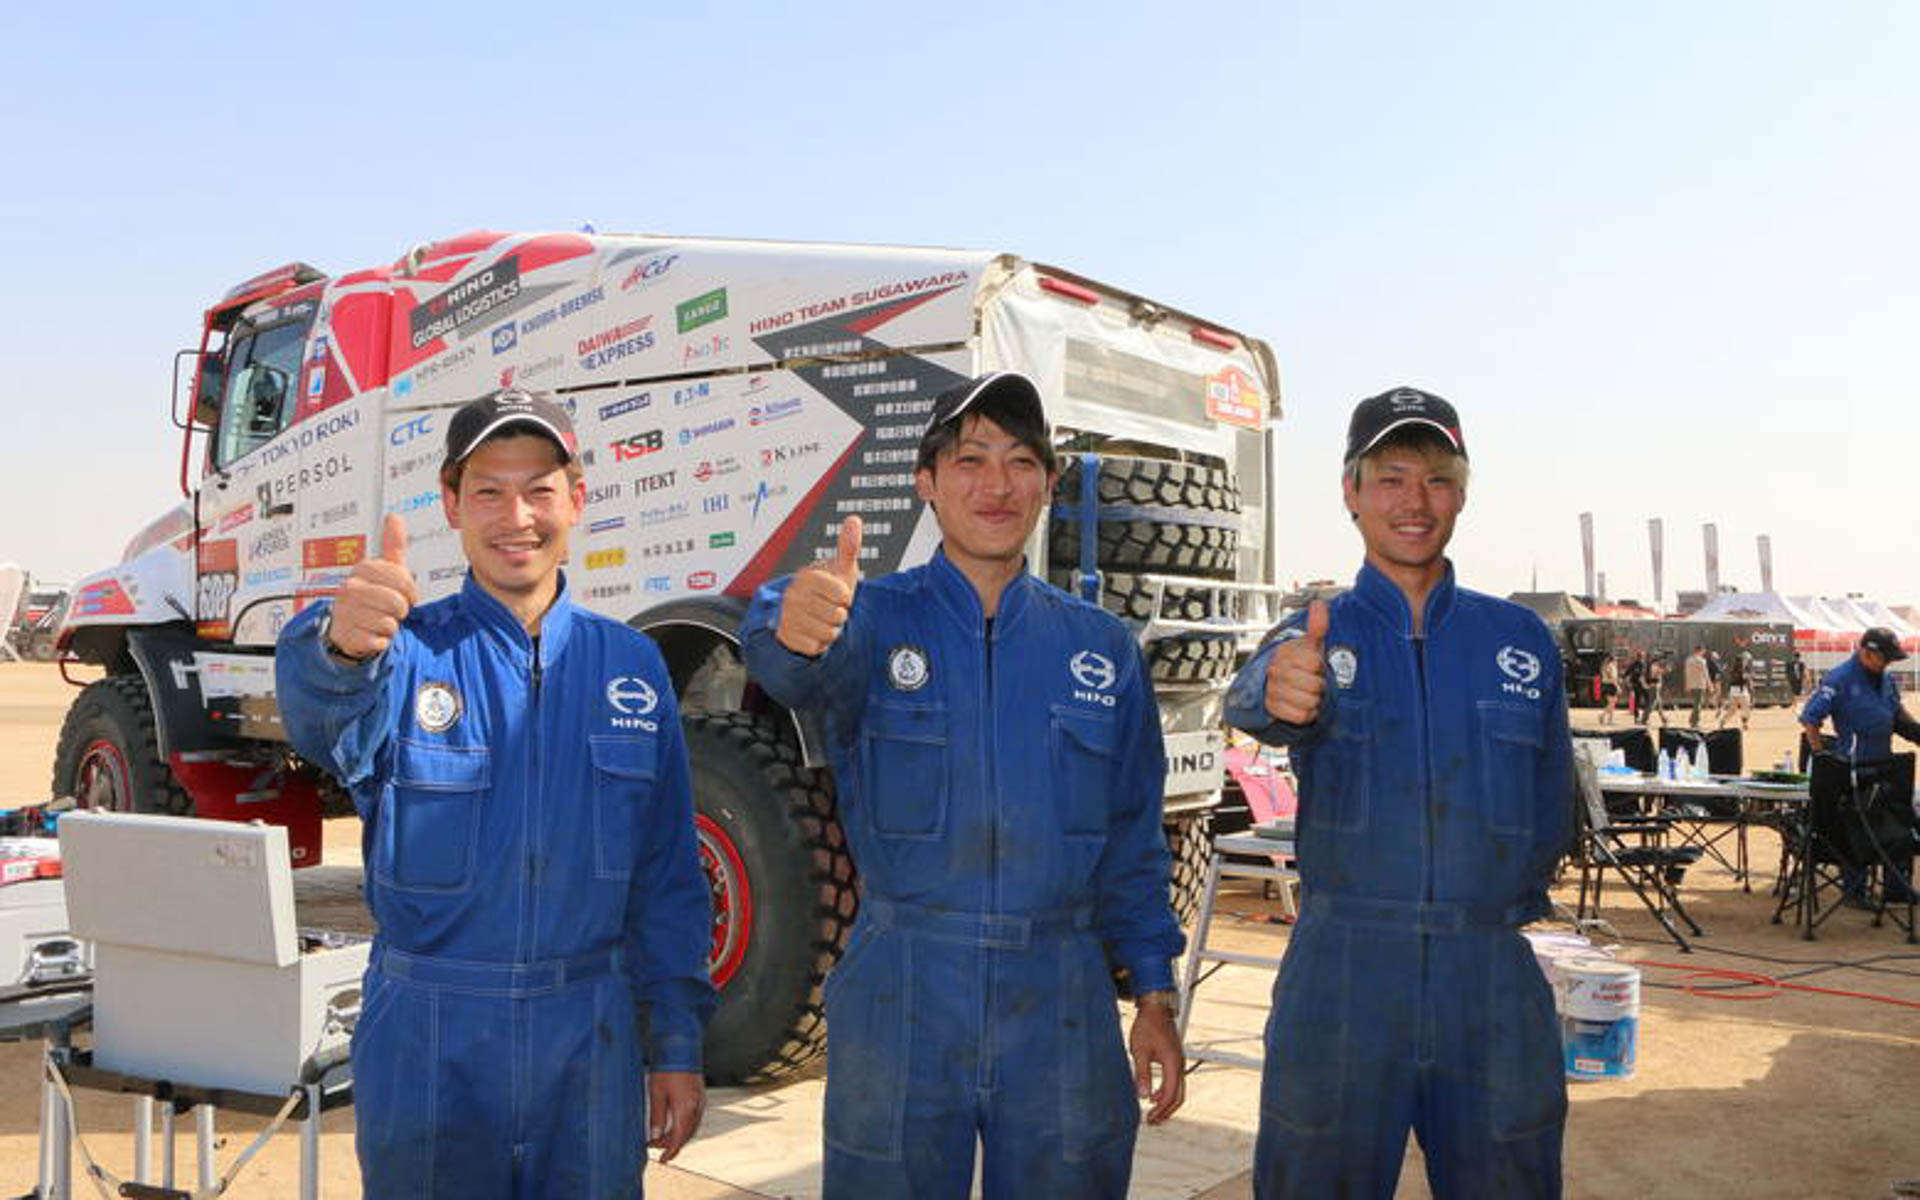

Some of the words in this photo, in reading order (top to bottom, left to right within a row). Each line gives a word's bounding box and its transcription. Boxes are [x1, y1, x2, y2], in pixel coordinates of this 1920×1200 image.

[447, 270, 494, 305] HINO
[750, 312, 795, 333] HINO
[798, 297, 847, 319] TEAM
[851, 270, 969, 305] SUGAWARA
[412, 312, 457, 348] GLOBAL
[457, 279, 519, 324] LOGISTICS
[577, 325, 622, 356] DAIWA
[586, 331, 655, 370] EXPRESS
[261, 429, 314, 466] TOKYO
[315, 408, 361, 441] ROKI
[390, 413, 434, 446] CTC
[609, 428, 664, 463] TSB
[275, 453, 353, 493] PERSOL
[634, 471, 677, 498] JTEKT
[703, 494, 729, 514] IHI
[611, 717, 659, 732] HINO
